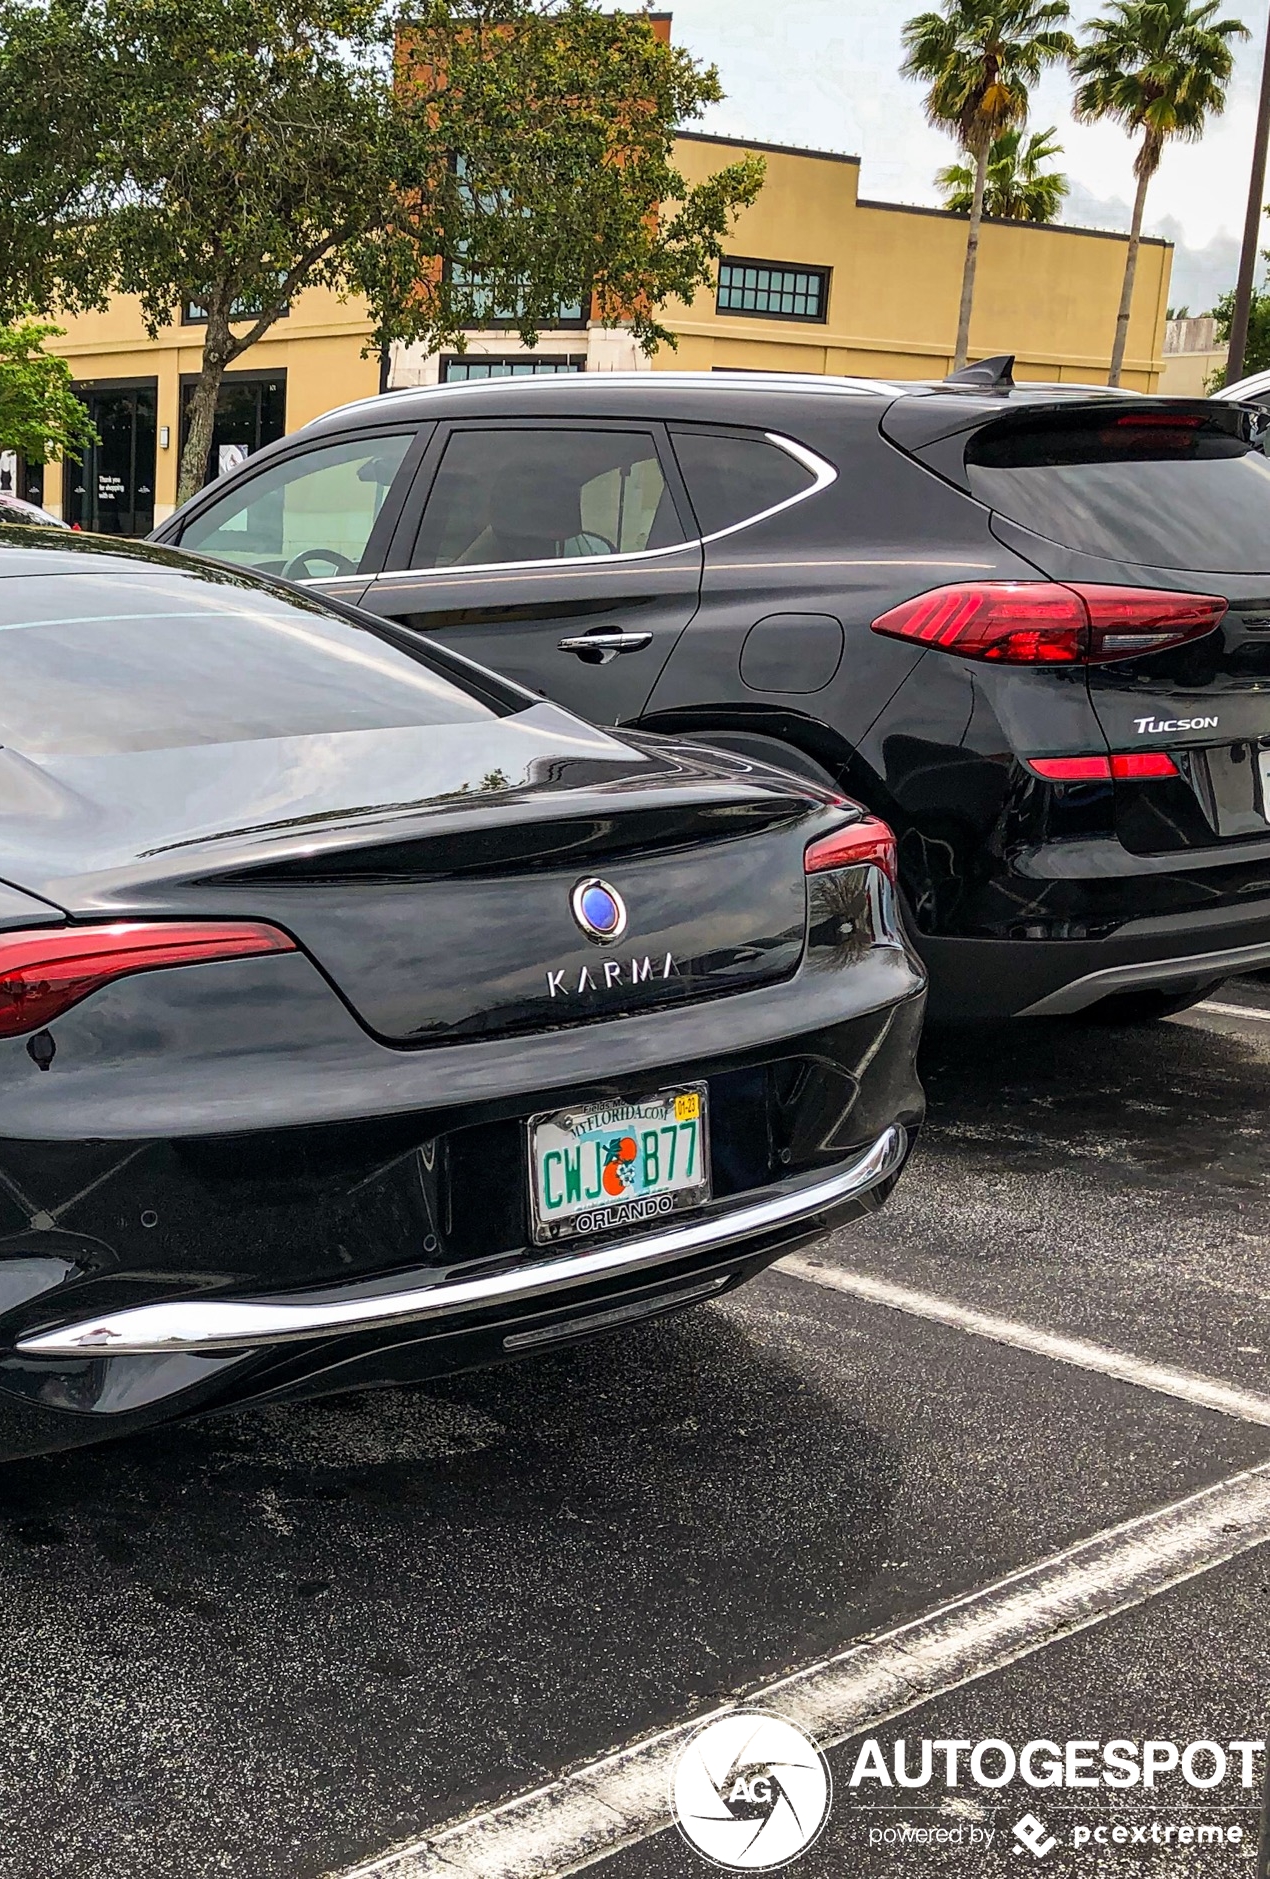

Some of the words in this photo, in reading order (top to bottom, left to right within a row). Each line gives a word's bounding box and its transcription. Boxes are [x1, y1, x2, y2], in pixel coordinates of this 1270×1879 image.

[98, 475, 112, 483] Thank
[105, 484, 125, 493] shopping
[547, 952, 681, 998] KARMA
[582, 1102, 611, 1114] Fields
[678, 1097, 696, 1116] 01-23
[543, 1141, 602, 1210] CWJ
[641, 1120, 697, 1188] B77
[576, 1195, 673, 1233] ORLANDO
